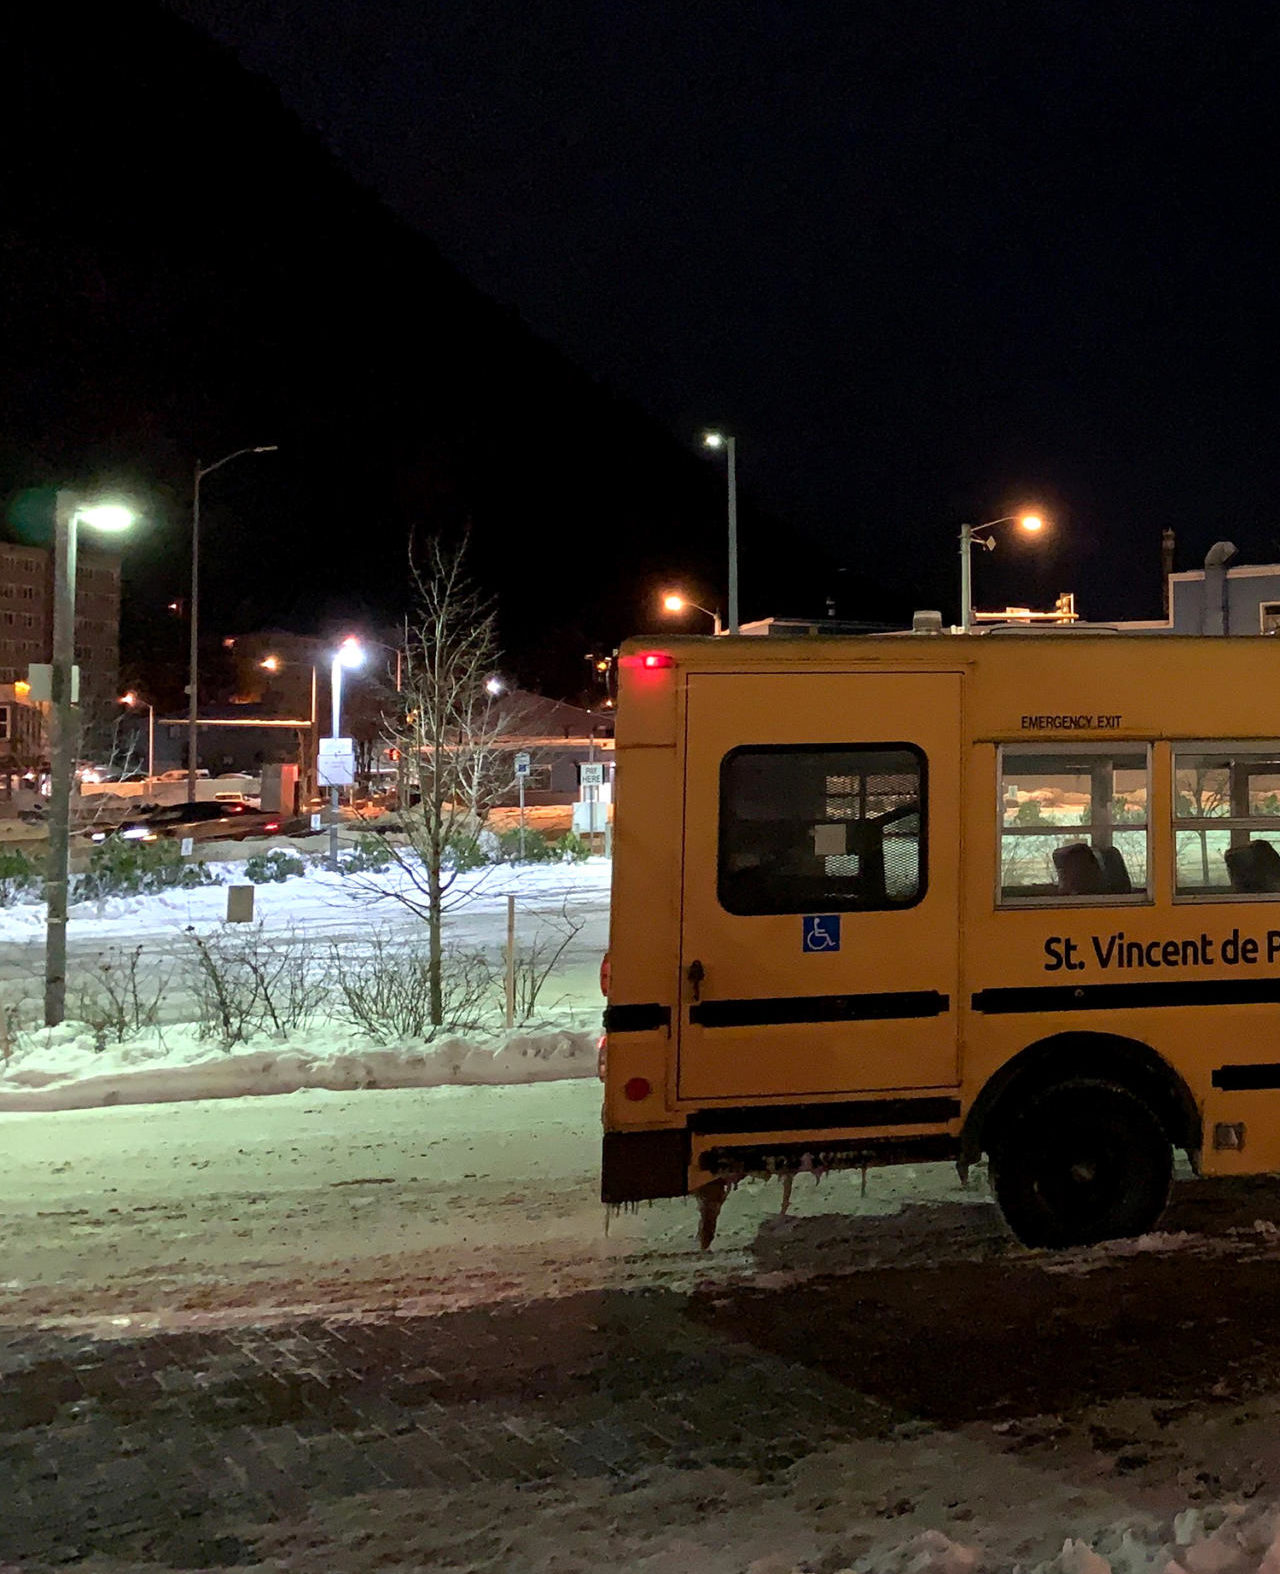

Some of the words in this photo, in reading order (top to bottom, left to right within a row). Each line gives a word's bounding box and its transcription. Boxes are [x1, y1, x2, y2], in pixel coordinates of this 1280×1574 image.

[1021, 716, 1093, 729] EMERGENCY
[1097, 715, 1122, 728] EXIT
[1044, 936, 1085, 971] St.
[1091, 932, 1214, 969] Vincent
[1221, 928, 1259, 965] de
